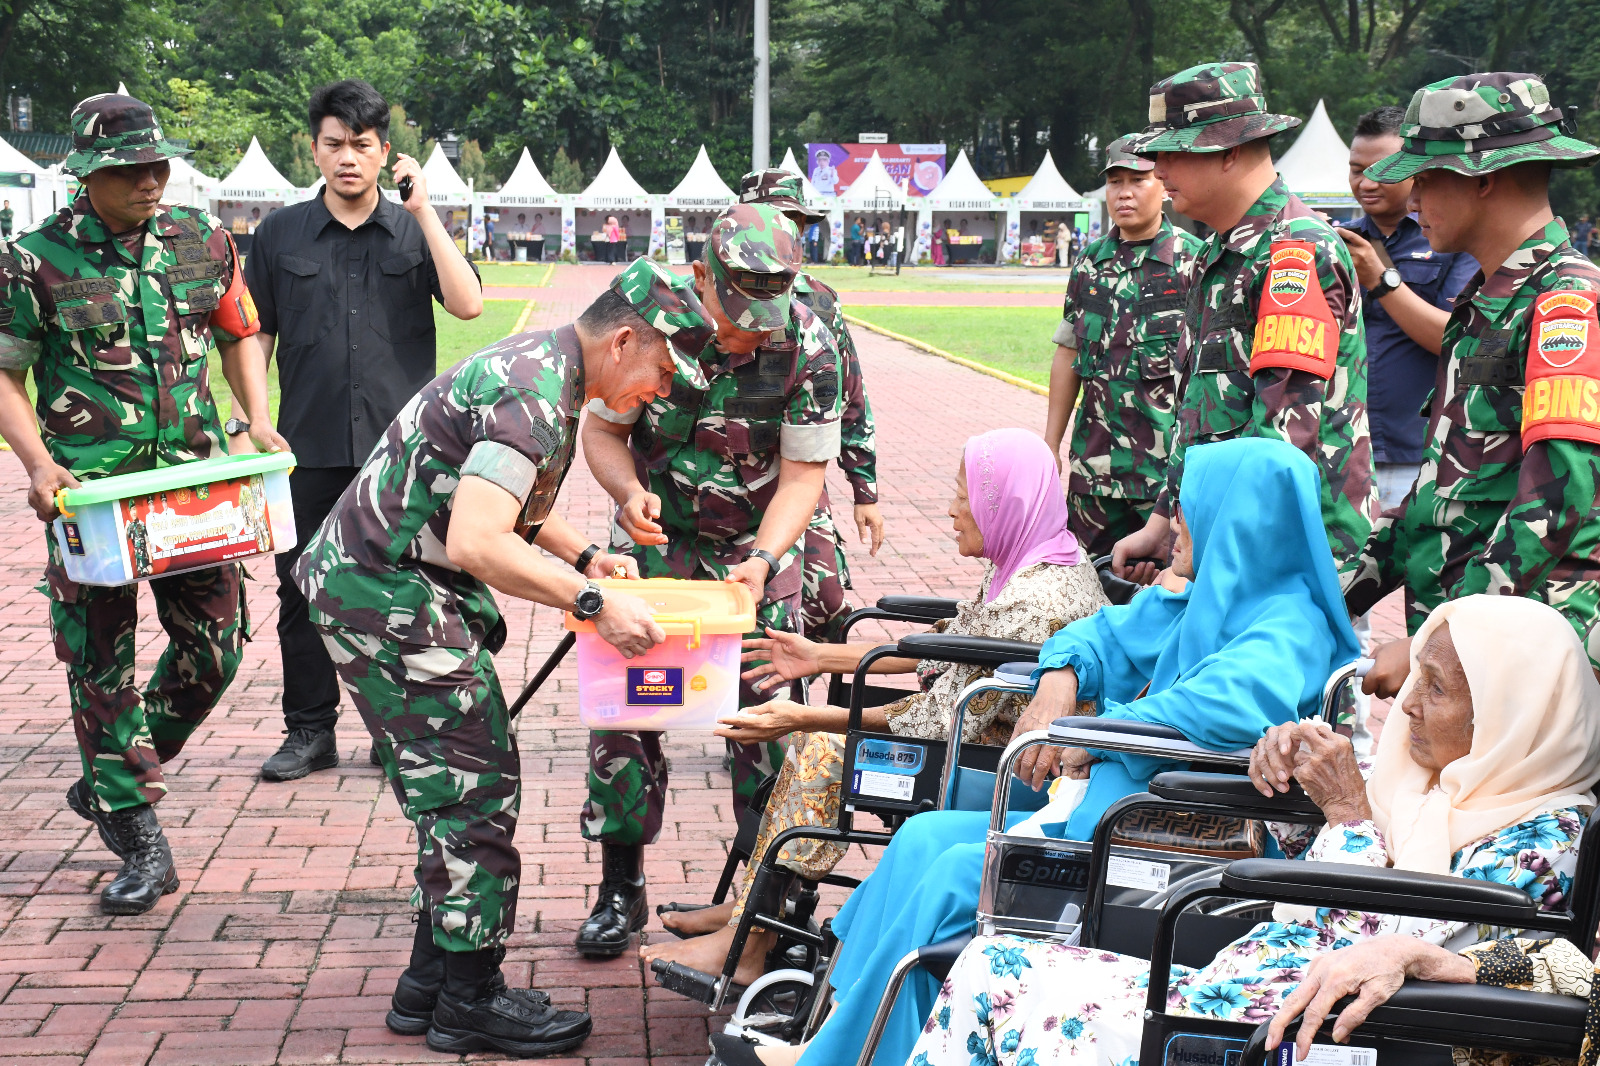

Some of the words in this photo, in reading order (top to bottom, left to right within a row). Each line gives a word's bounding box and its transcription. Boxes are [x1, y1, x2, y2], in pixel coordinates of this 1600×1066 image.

[246, 190, 265, 198] MEDAN
[500, 196, 516, 204] DAPUR
[614, 197, 632, 205] SNACK
[1273, 249, 1295, 262] KODIM
[1295, 250, 1311, 262] 0201
[172, 267, 195, 280] TNI
[1540, 296, 1567, 312] KODIM
[162, 533, 188, 546] KODIM
[862, 748, 895, 761] Husada
[897, 752, 915, 763] 875
[1015, 859, 1086, 886] Spirit
[1173, 1048, 1224, 1066] Husada
